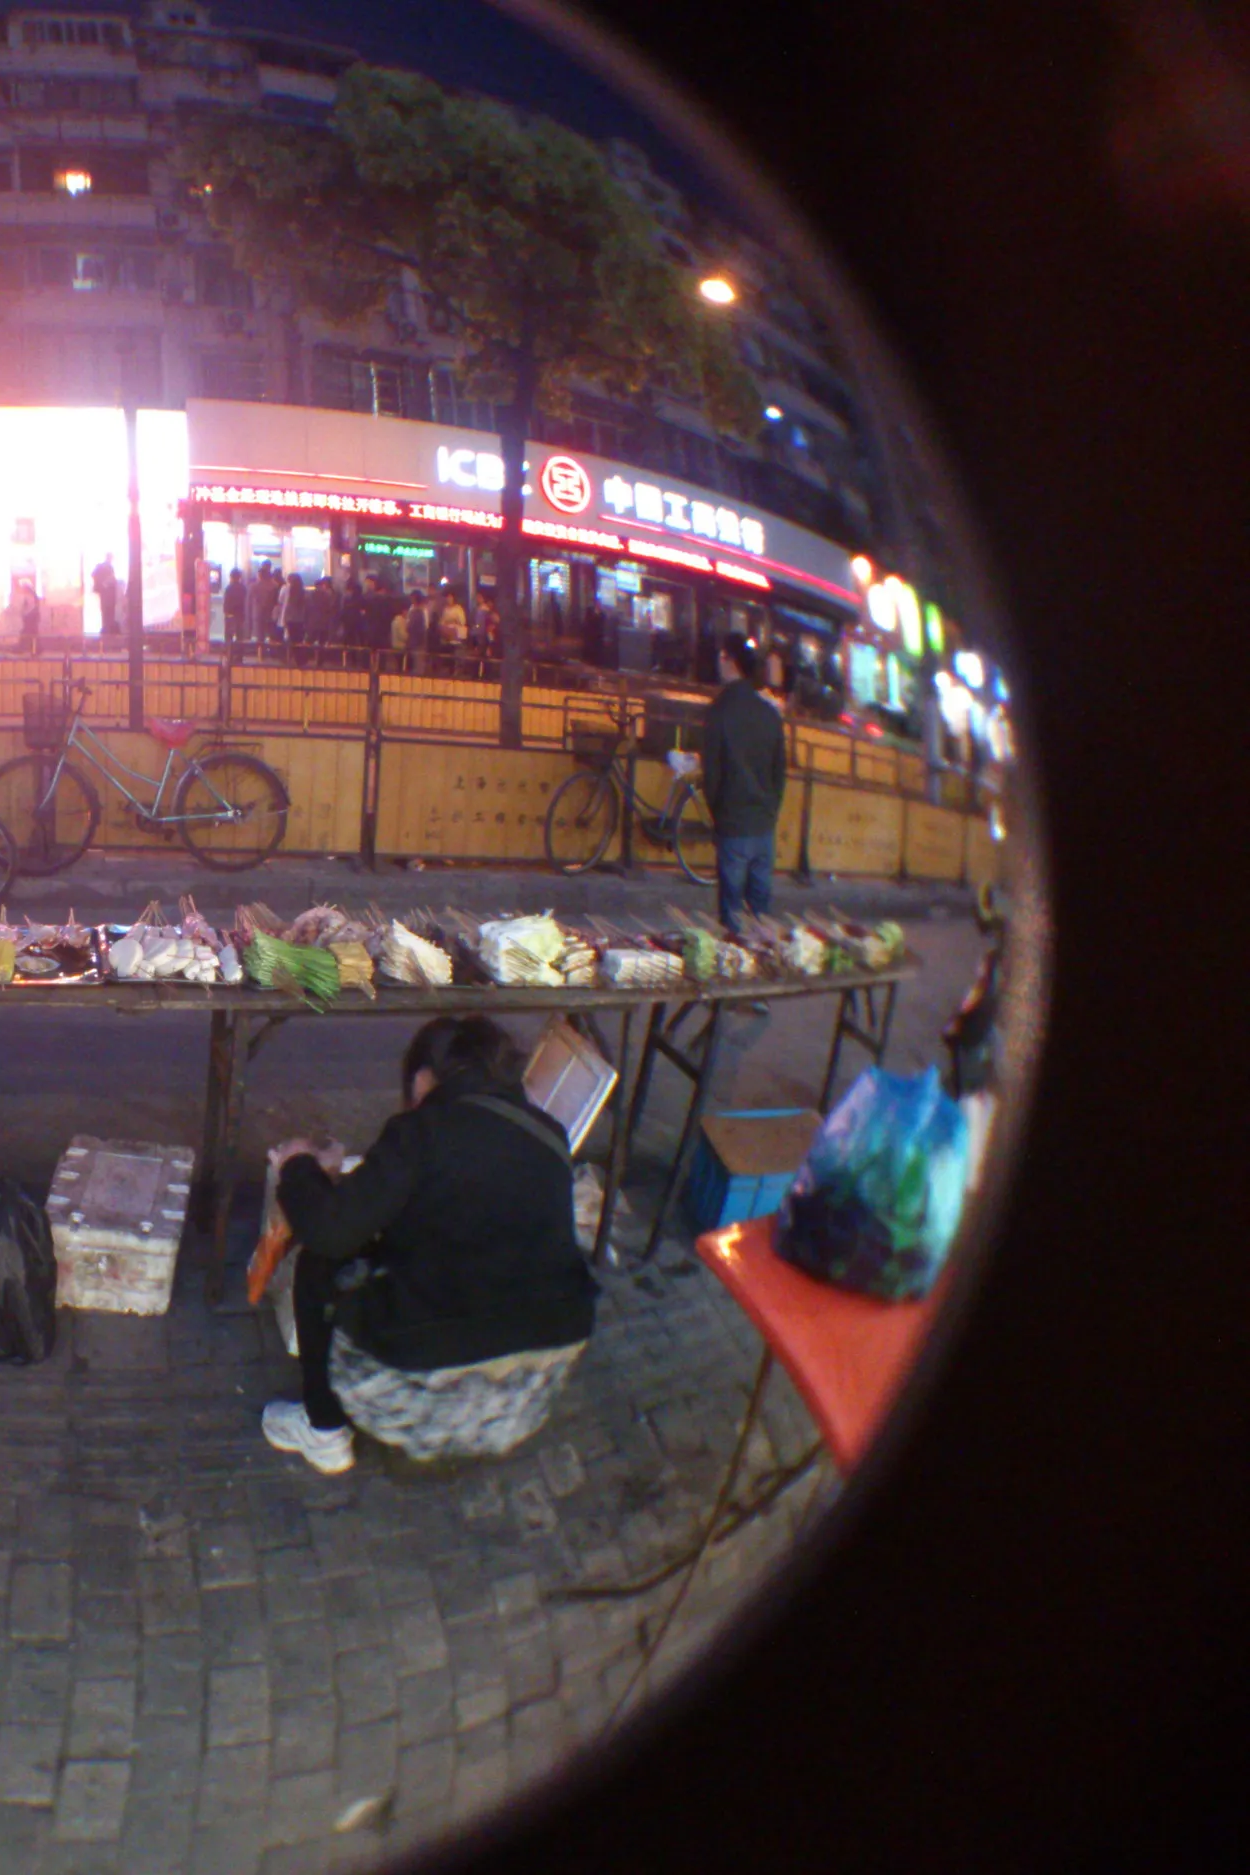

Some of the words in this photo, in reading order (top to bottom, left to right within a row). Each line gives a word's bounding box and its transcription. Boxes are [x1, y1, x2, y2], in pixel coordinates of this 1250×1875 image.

[437, 445, 533, 496] ICB
[602, 474, 765, 556] 中国工商银行
